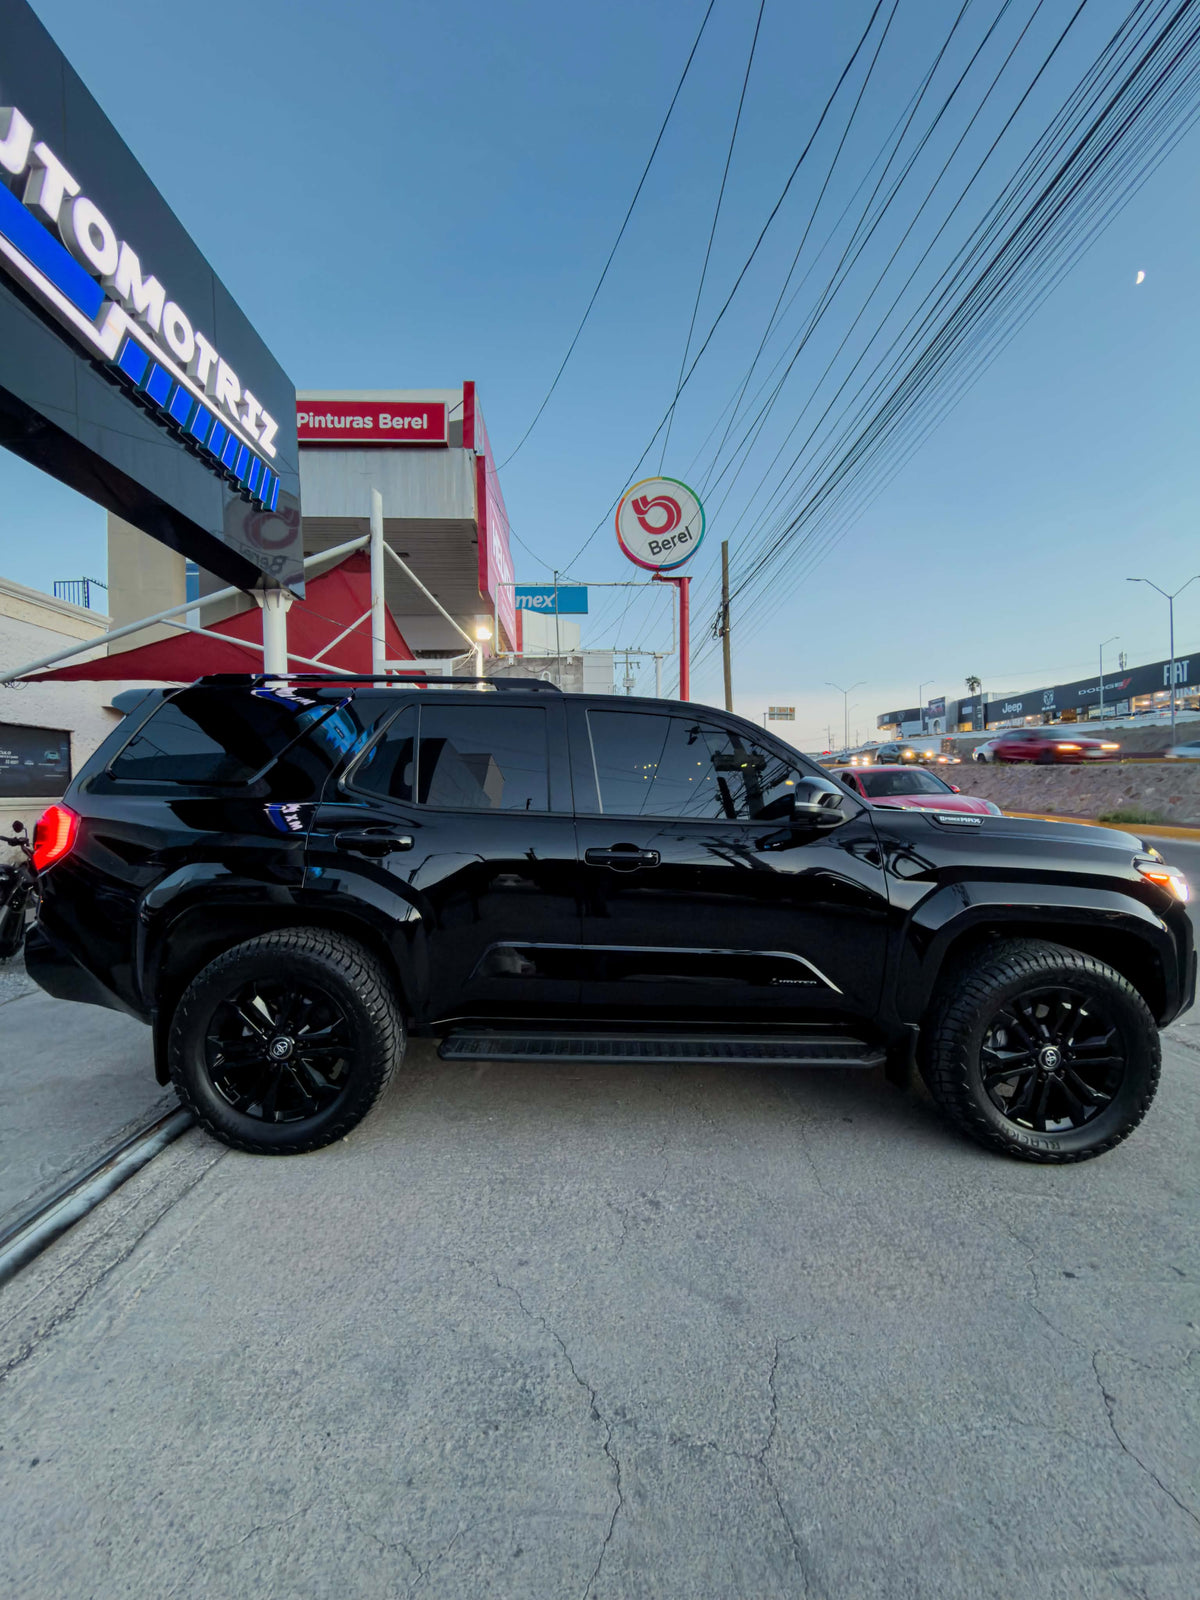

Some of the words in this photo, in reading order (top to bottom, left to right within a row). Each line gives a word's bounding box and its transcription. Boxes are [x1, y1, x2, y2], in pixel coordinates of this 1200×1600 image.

[296, 412, 373, 429] Pinturas
[379, 413, 428, 430] Berel
[648, 525, 693, 556] Berel
[515, 591, 558, 608] mex
[1163, 660, 1190, 686] FIAT
[1078, 681, 1125, 696] DODGE
[1002, 702, 1023, 714] Jeep
